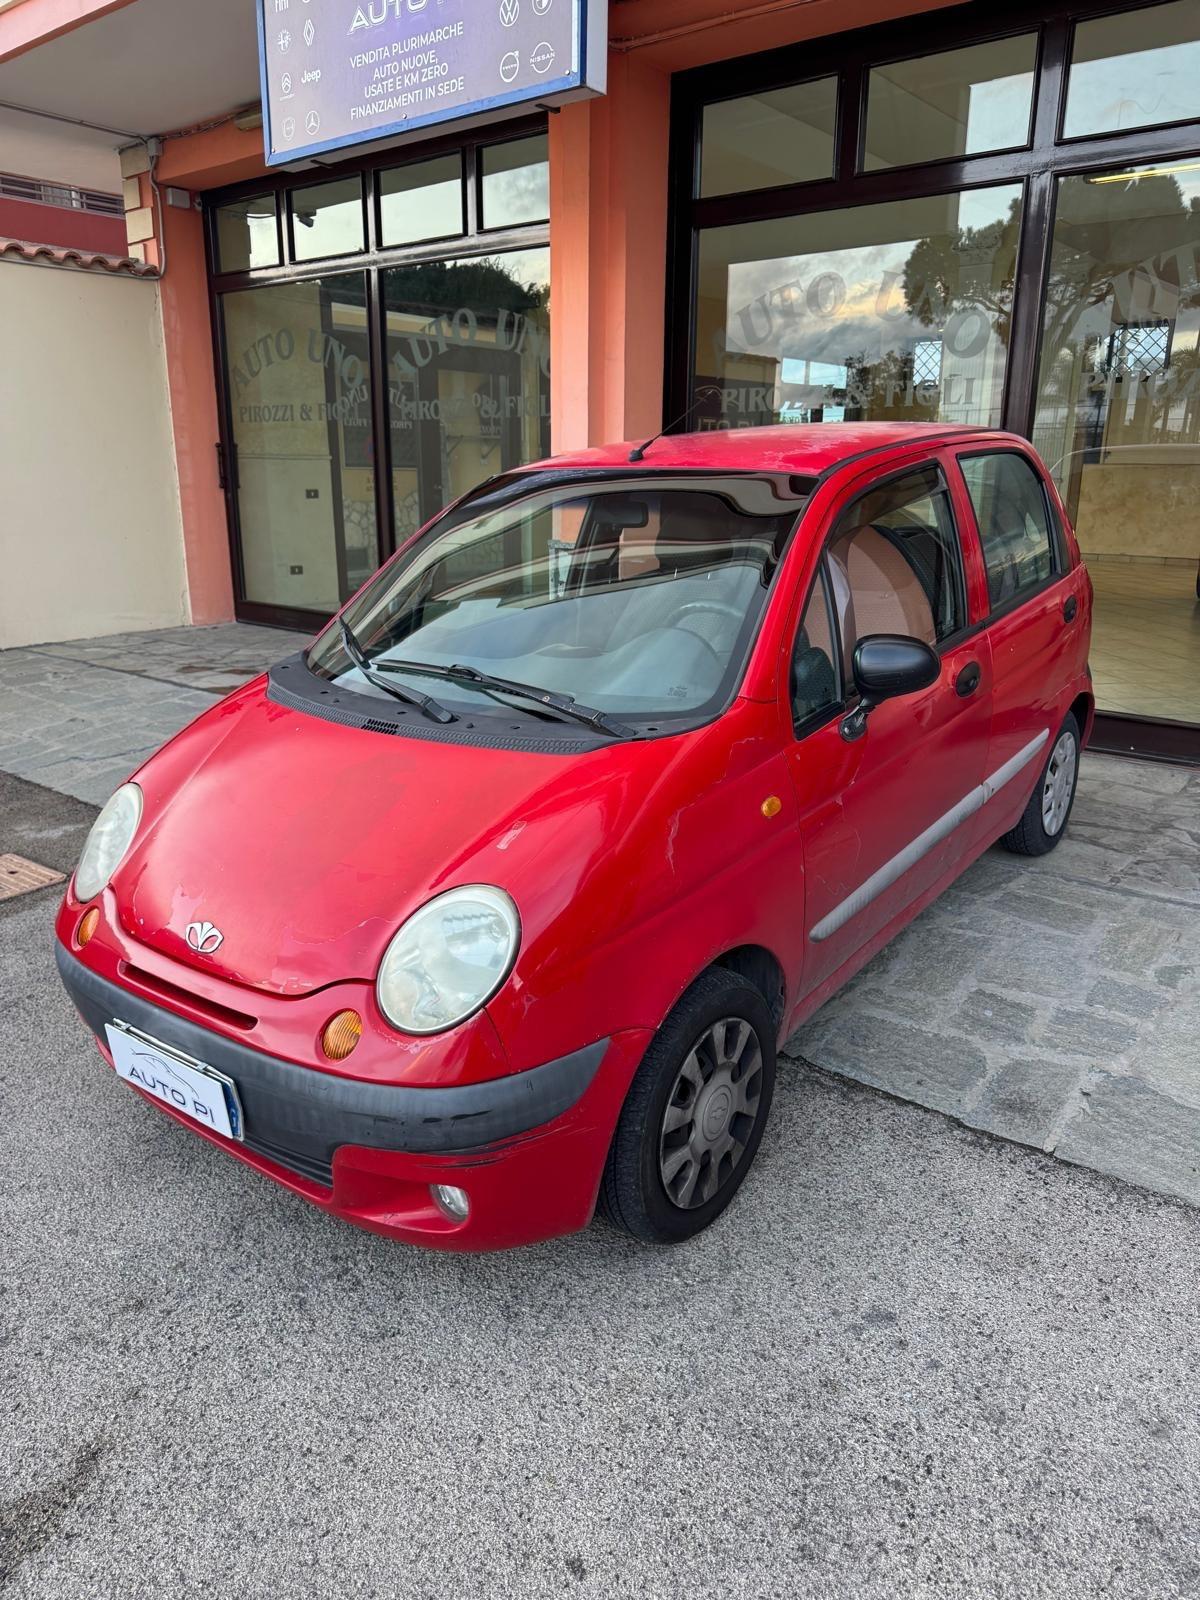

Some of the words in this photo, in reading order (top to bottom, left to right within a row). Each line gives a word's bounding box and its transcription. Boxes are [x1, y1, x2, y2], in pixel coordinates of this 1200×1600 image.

[350, 47, 390, 69] VENDITA
[392, 21, 464, 56] PLURIMARCHE
[373, 61, 399, 81] AUTO
[401, 49, 438, 72] NUOVE,
[529, 51, 556, 64] NISSAN
[301, 69, 321, 84] Jeep
[364, 78, 394, 98] USATE
[396, 76, 402, 90] E
[404, 71, 419, 87] KM
[421, 62, 449, 82] ZERO
[350, 89, 423, 121] FINANZIAMENTI
[425, 85, 436, 99] IN
[437, 76, 465, 96] SEDE
[231, 327, 295, 398] AUTO
[307, 327, 364, 388] UNO
[392, 308, 478, 393] AUTO
[240, 404, 294, 423] PIROZZI
[300, 402, 312, 421] &
[129, 1065, 187, 1107] AUTO
[193, 1099, 215, 1124] PI
